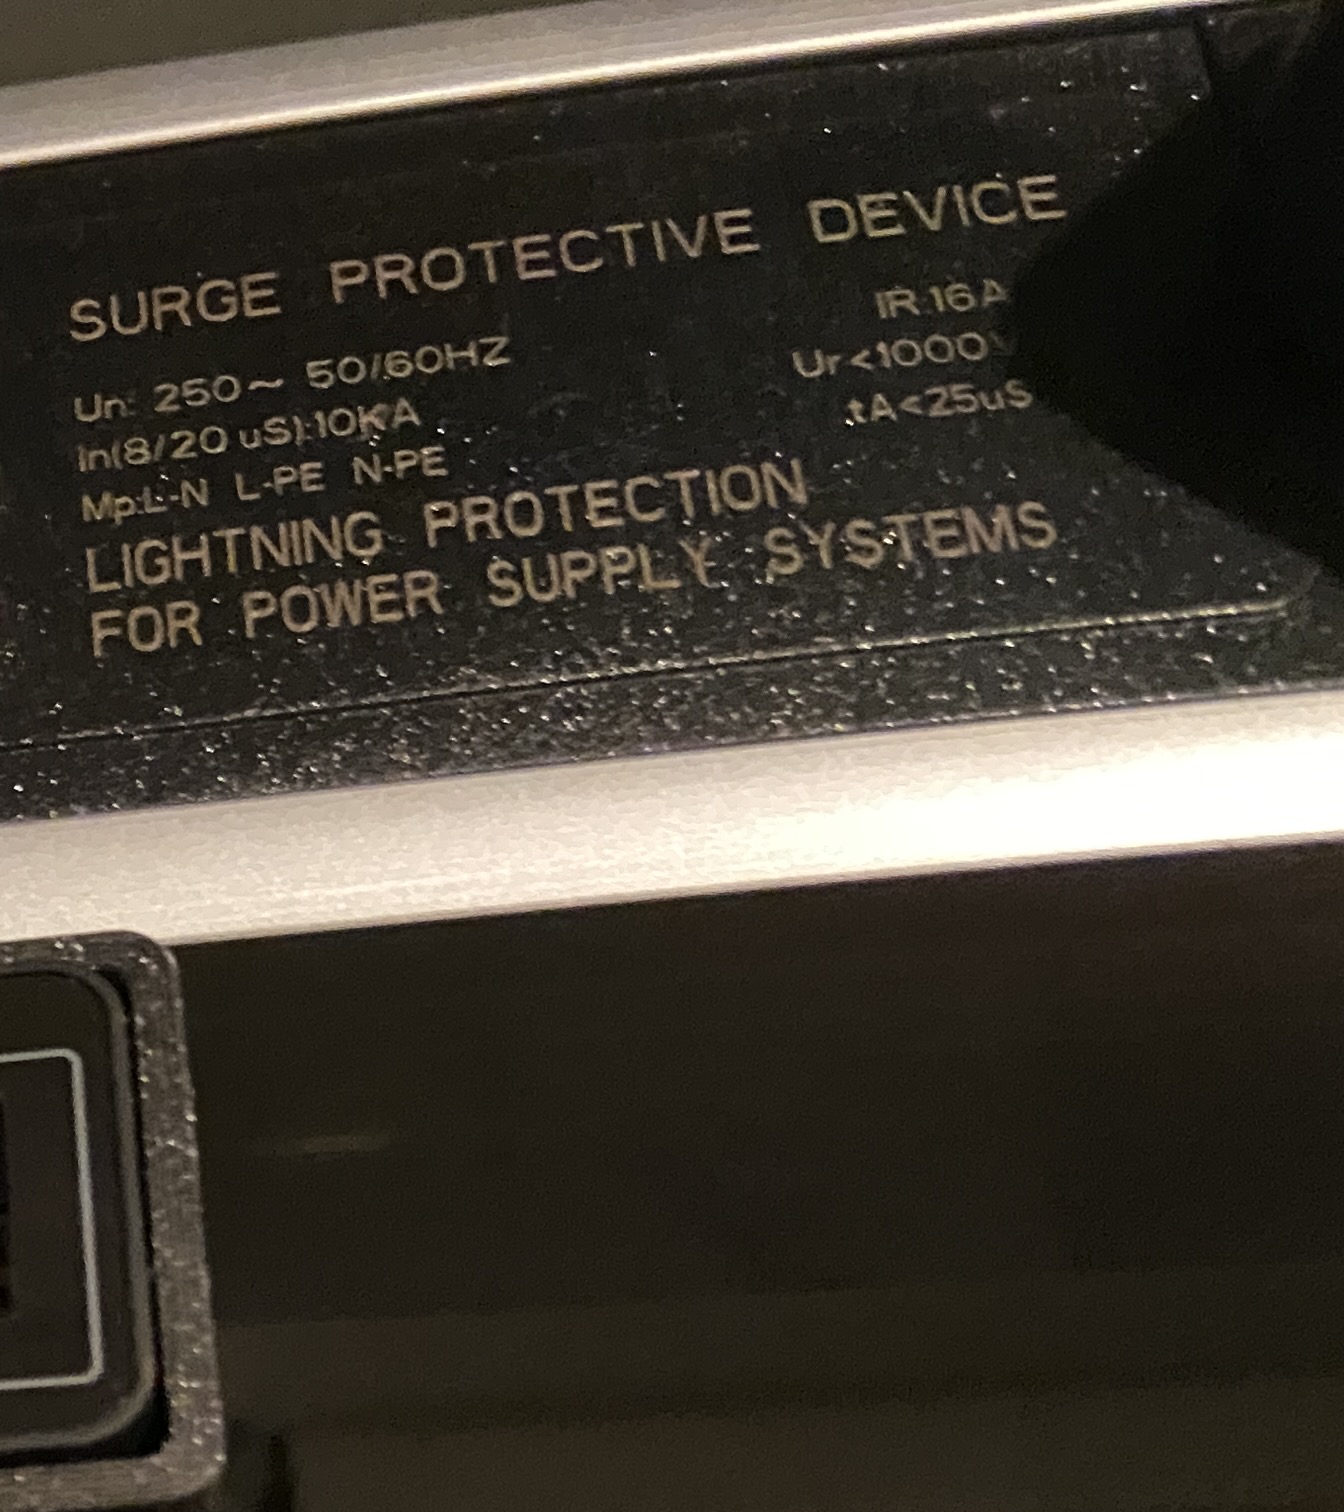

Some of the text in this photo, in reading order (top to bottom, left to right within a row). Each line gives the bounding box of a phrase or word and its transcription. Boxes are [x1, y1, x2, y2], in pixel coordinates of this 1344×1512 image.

[69, 172, 1069, 344] SURGE PROTECTIVE DEVICE
[305, 336, 512, 390] 50/60HZ
[84, 457, 811, 594] LIGHTNING PROTECTION
[234, 461, 327, 501] L-PE
[351, 445, 450, 486] N-PE
[89, 499, 1059, 658] FOR POWER SUPPLY SYSTEMS
